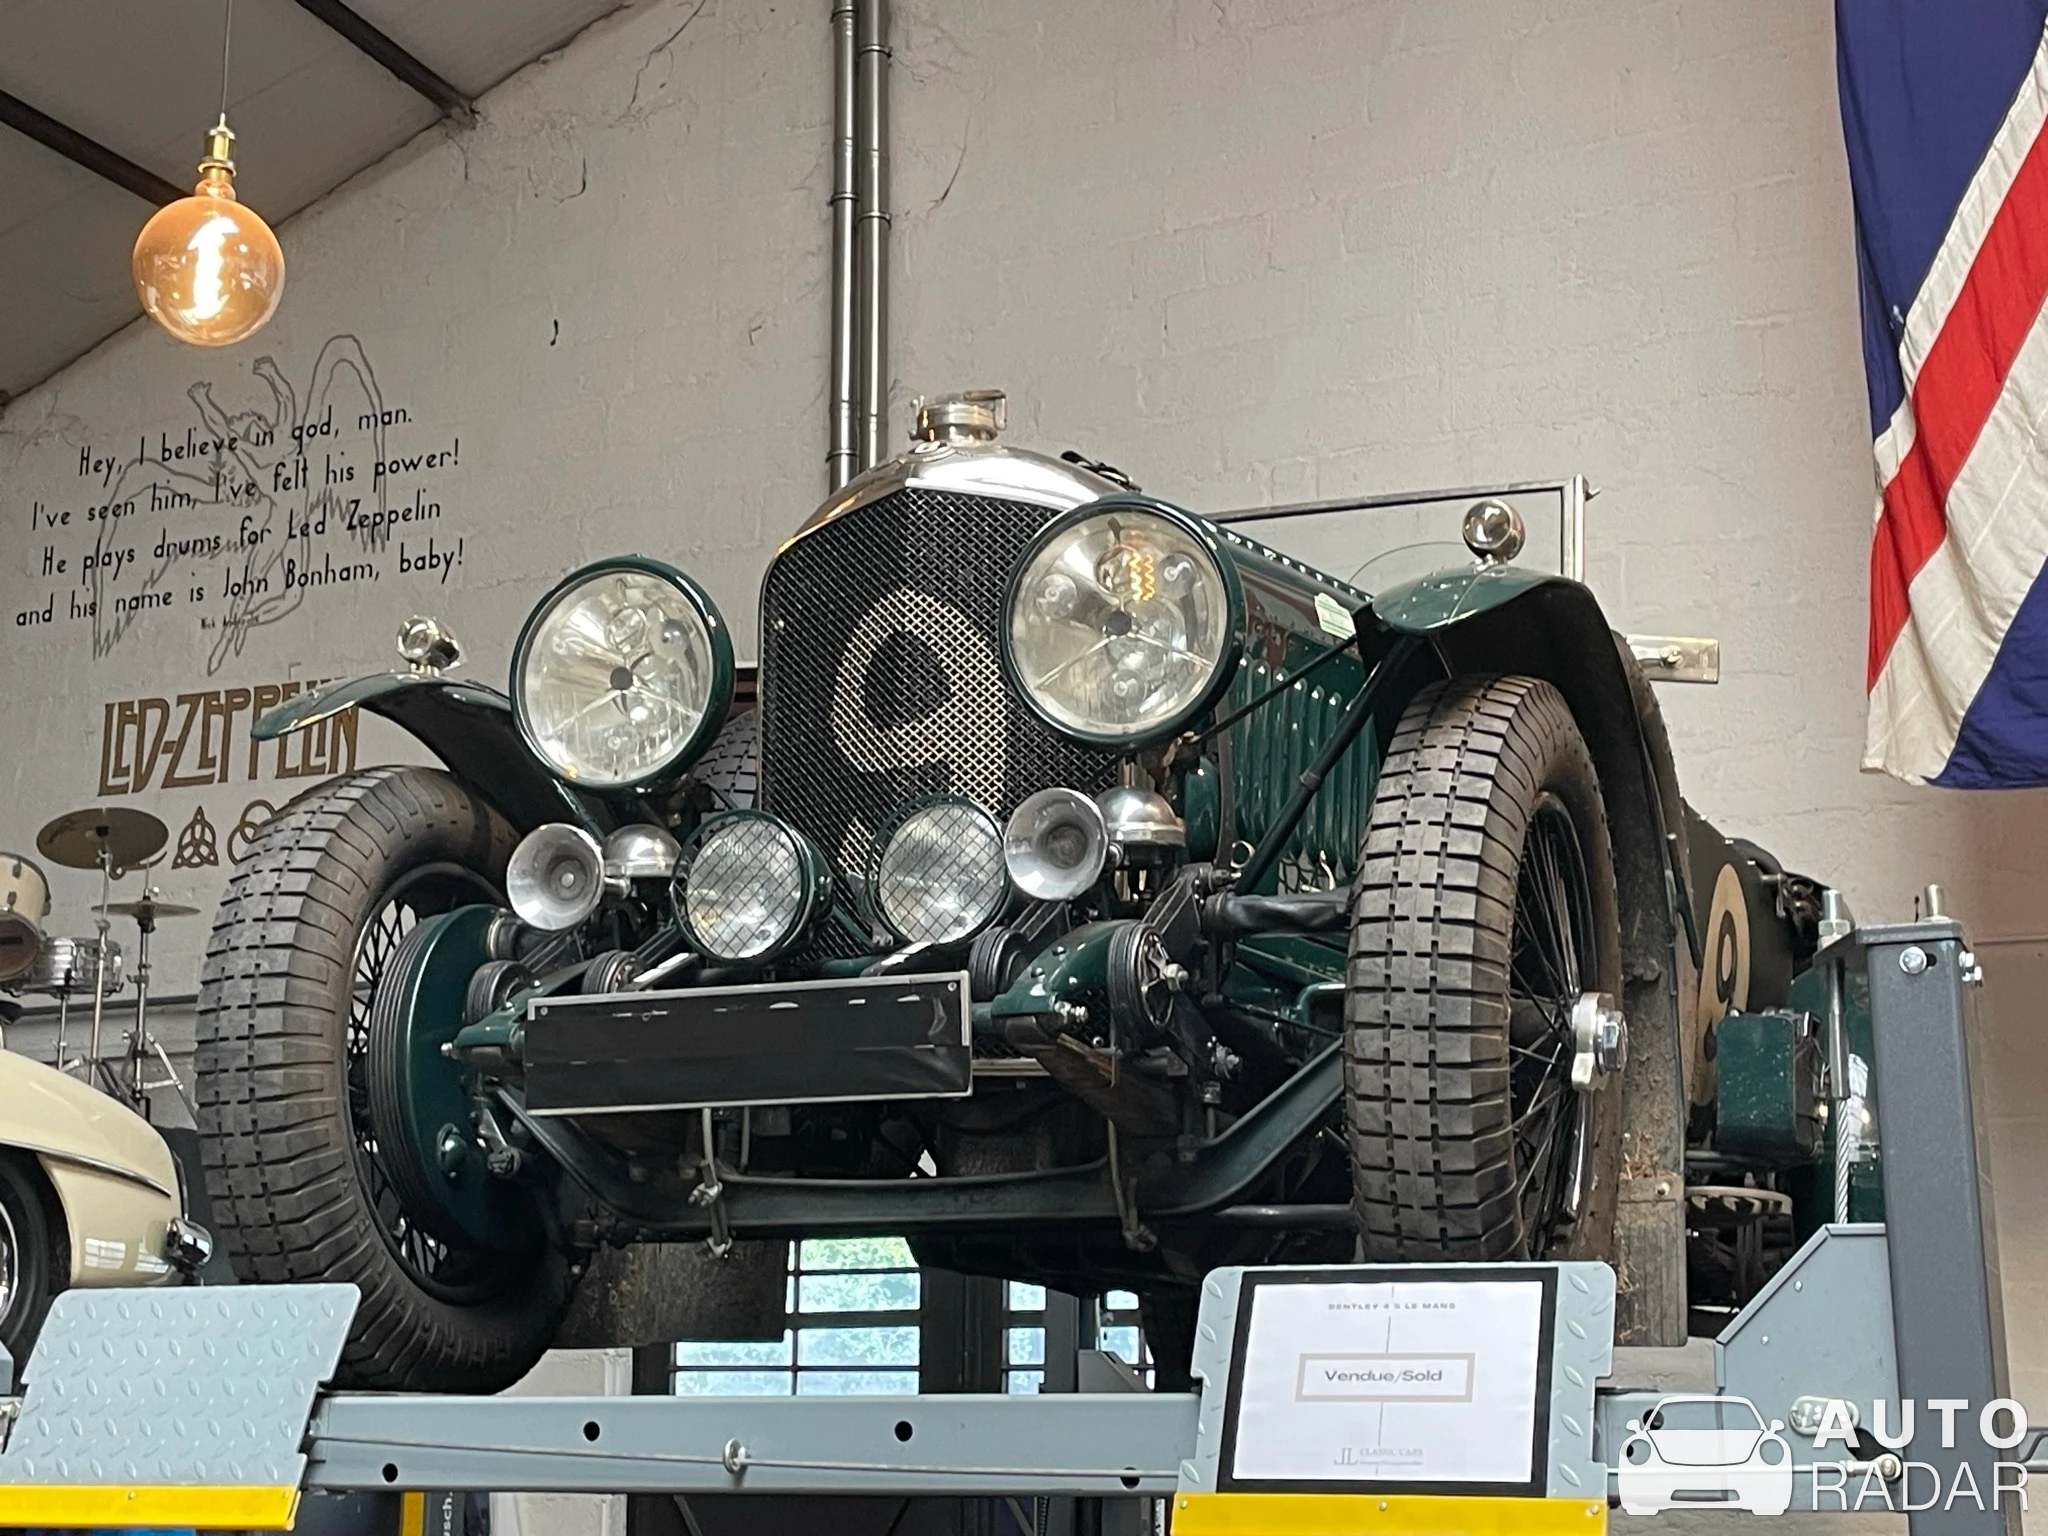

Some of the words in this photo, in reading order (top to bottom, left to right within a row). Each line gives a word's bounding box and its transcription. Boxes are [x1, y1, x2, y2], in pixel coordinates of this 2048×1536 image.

[32, 501, 71, 531] I've
[87, 499, 136, 522] seen
[150, 480, 200, 512] him,
[215, 472, 258, 502] I've
[273, 457, 310, 494] felt
[325, 451, 355, 484] his
[373, 438, 460, 493] power!
[79, 446, 122, 488] Hey,
[139, 436, 146, 466] I
[161, 428, 239, 463] believe
[255, 424, 275, 448] in
[292, 404, 340, 456] god,
[358, 409, 413, 431] man.
[42, 545, 67, 577] He
[82, 538, 136, 585] plays
[153, 528, 222, 559] drums
[239, 515, 272, 549] for
[287, 503, 327, 539] Led
[346, 489, 442, 542] Zeppelin
[16, 593, 53, 627] and
[70, 587, 97, 620] his
[115, 591, 173, 613] name
[189, 572, 205, 602] is
[222, 566, 269, 599] John
[285, 552, 381, 589] Bonham,
[400, 538, 464, 584] baby!
[1324, 1369, 1443, 1383] Vendue/Sold
